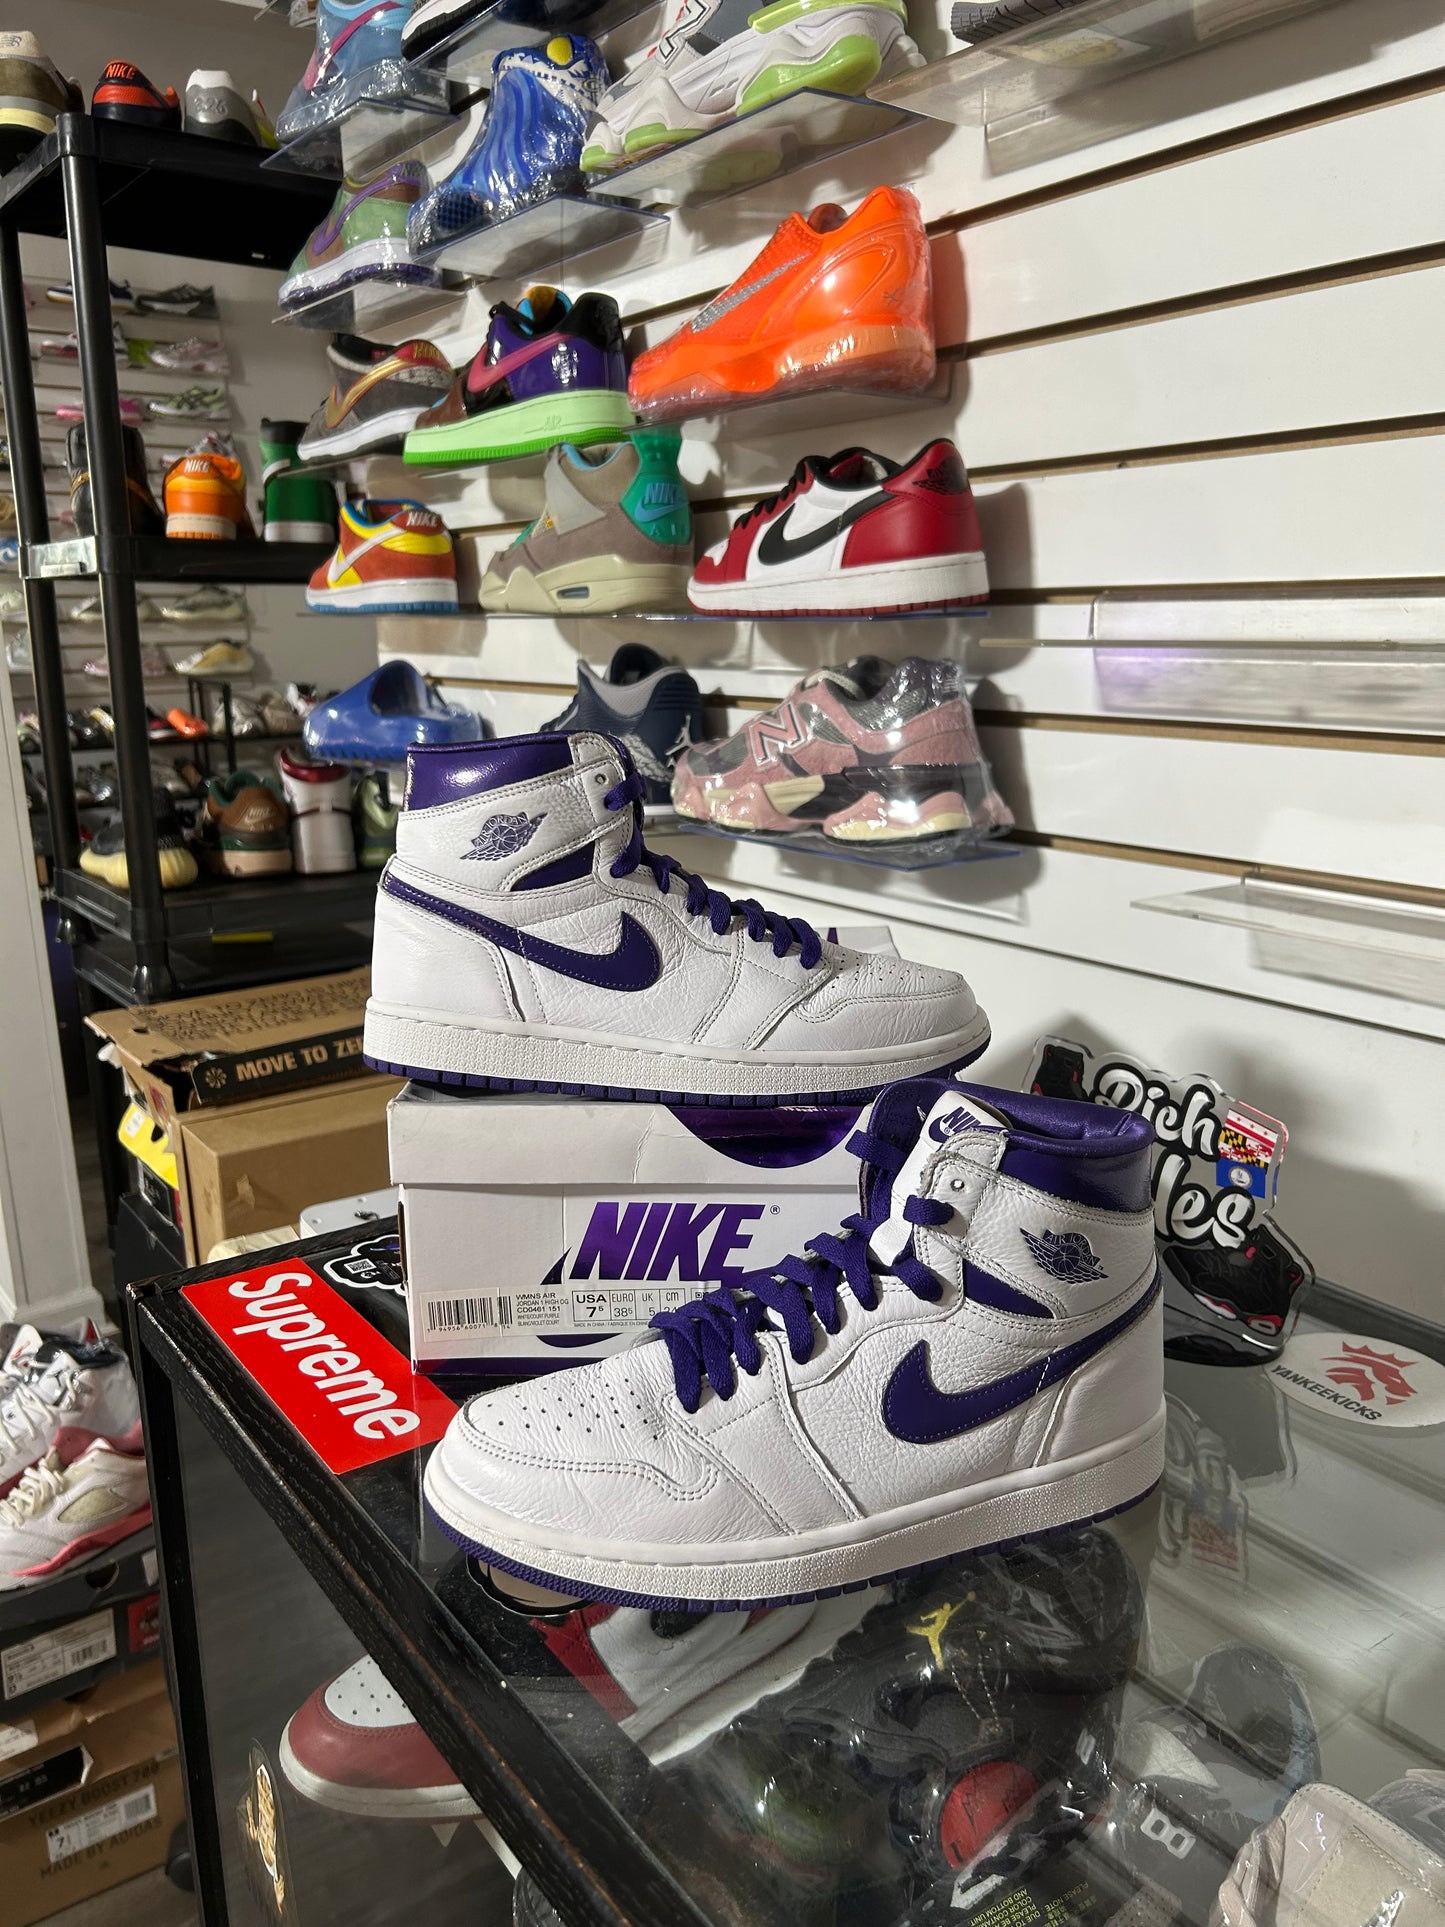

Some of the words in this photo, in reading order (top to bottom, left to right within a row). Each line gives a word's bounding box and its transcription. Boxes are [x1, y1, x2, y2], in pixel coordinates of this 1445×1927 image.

[105, 64, 136, 79] NIKE
[184, 459, 209, 473] NIKE
[406, 511, 438, 528] NIKE
[236, 1051, 298, 1081] MOVE
[300, 1044, 329, 1066] TO
[332, 1036, 364, 1059] ZE
[942, 1106, 981, 1133] NI
[1153, 1151, 1255, 1250] les
[569, 1201, 766, 1283] NIKE
[576, 1294, 607, 1304] USA
[611, 1292, 634, 1303] EURO
[641, 1293, 654, 1302] UK
[228, 1272, 421, 1440] Supreme
[1270, 1364, 1383, 1422] YANKEEKICKS
[1013, 1888, 1028, 1901] AND
[985, 1897, 1014, 1918] BOTTOM
[1008, 1896, 1032, 1914] COLOR
[1010, 1903, 1037, 1922] PLEASE
[1044, 1896, 1064, 1912] NOTE
[1000, 1917, 1011, 1927] BE
[1025, 1910, 1041, 1923] DUE
